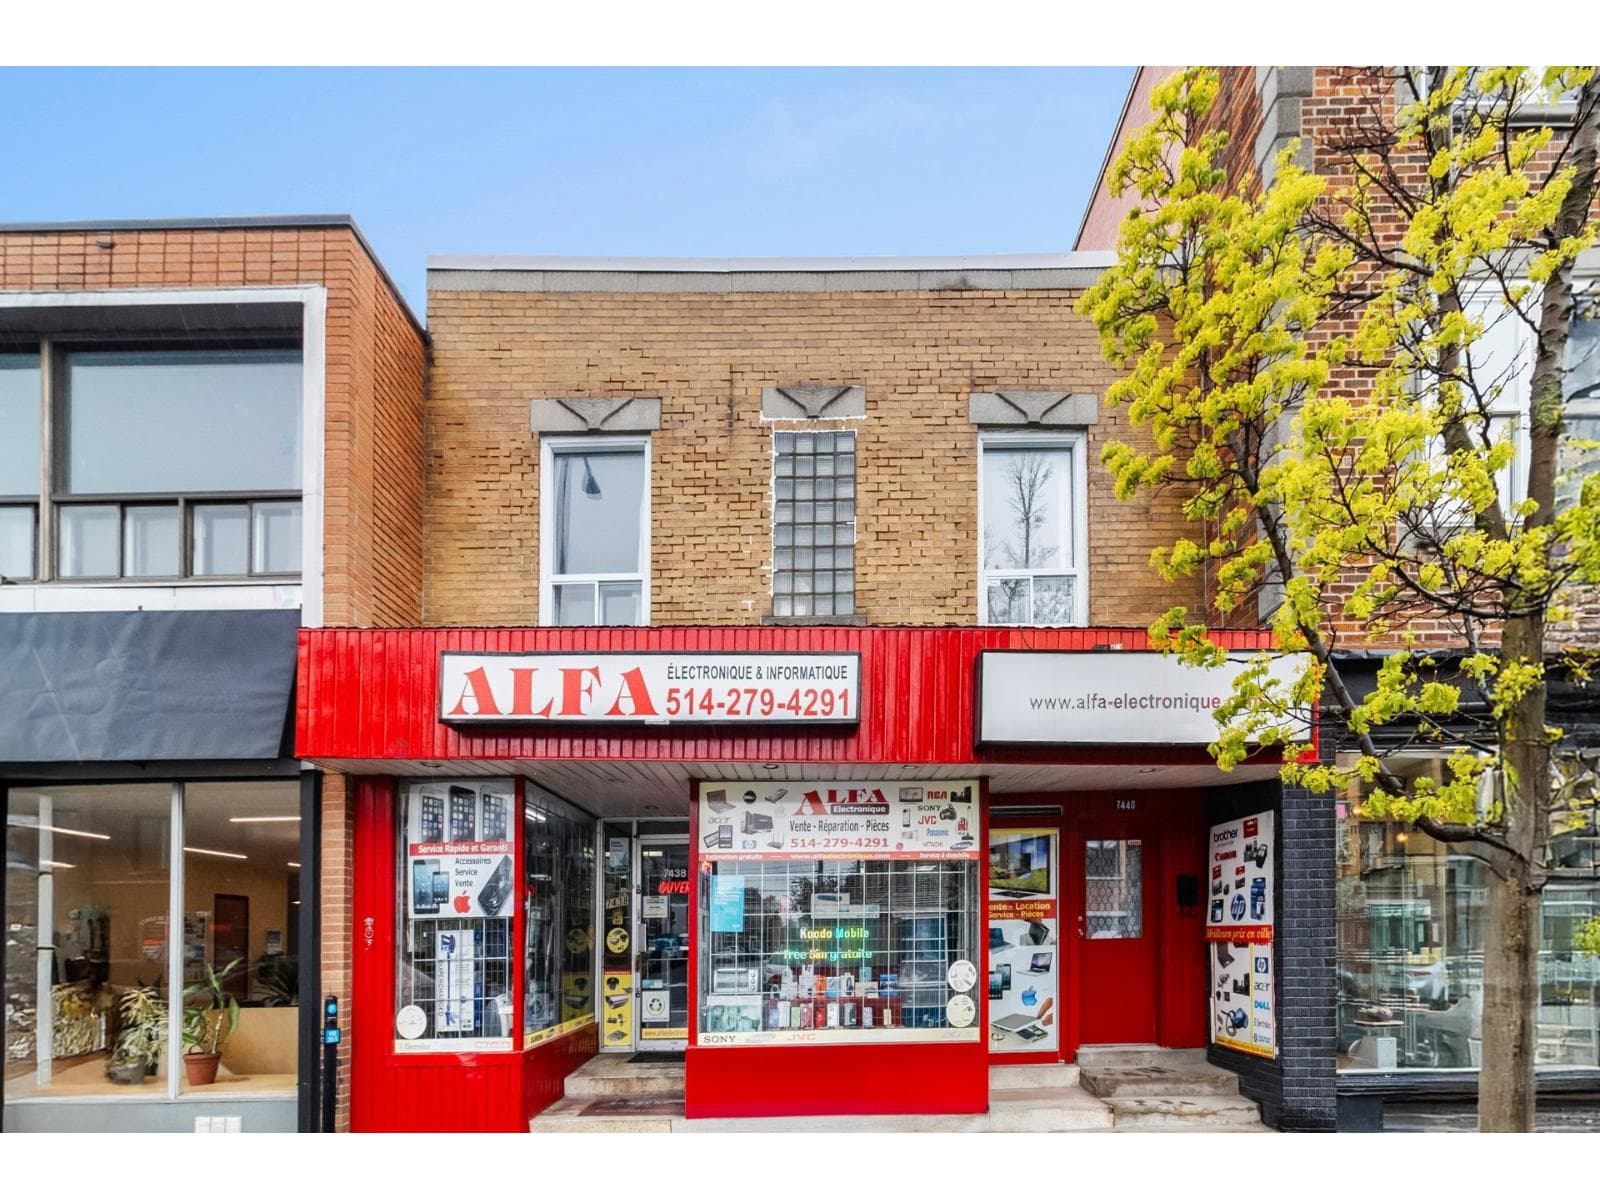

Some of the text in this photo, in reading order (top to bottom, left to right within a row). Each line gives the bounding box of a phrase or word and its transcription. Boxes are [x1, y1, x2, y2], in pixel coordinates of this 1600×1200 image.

[668, 662, 848, 680] ÉLECTRONIQUE & INFORMATIQUE
[447, 666, 660, 720] ALFA
[666, 688, 850, 717] 514-279-4291
[927, 790, 948, 800] RCA
[792, 788, 889, 816] ALFA
[1116, 800, 1136, 810] 7440
[832, 804, 886, 814] Electronique
[918, 816, 937, 825] JVC
[790, 820, 812, 832] Vente
[818, 820, 859, 834] Réparation
[866, 818, 890, 832] Pièces
[1213, 828, 1239, 842] brother
[790, 837, 888, 848] 514-279-4291
[418, 845, 444, 854] Service
[445, 844, 470, 854] Rapide
[480, 844, 508, 852] Garanti
[1214, 850, 1237, 862] Canon
[664, 868, 687, 878] 7438
[1016, 902, 1050, 910] Location
[800, 927, 870, 939] Koodo Mobile
[1254, 982, 1270, 992] acer
[1254, 1000, 1270, 1010] DELL
[704, 1035, 736, 1044] SONY
